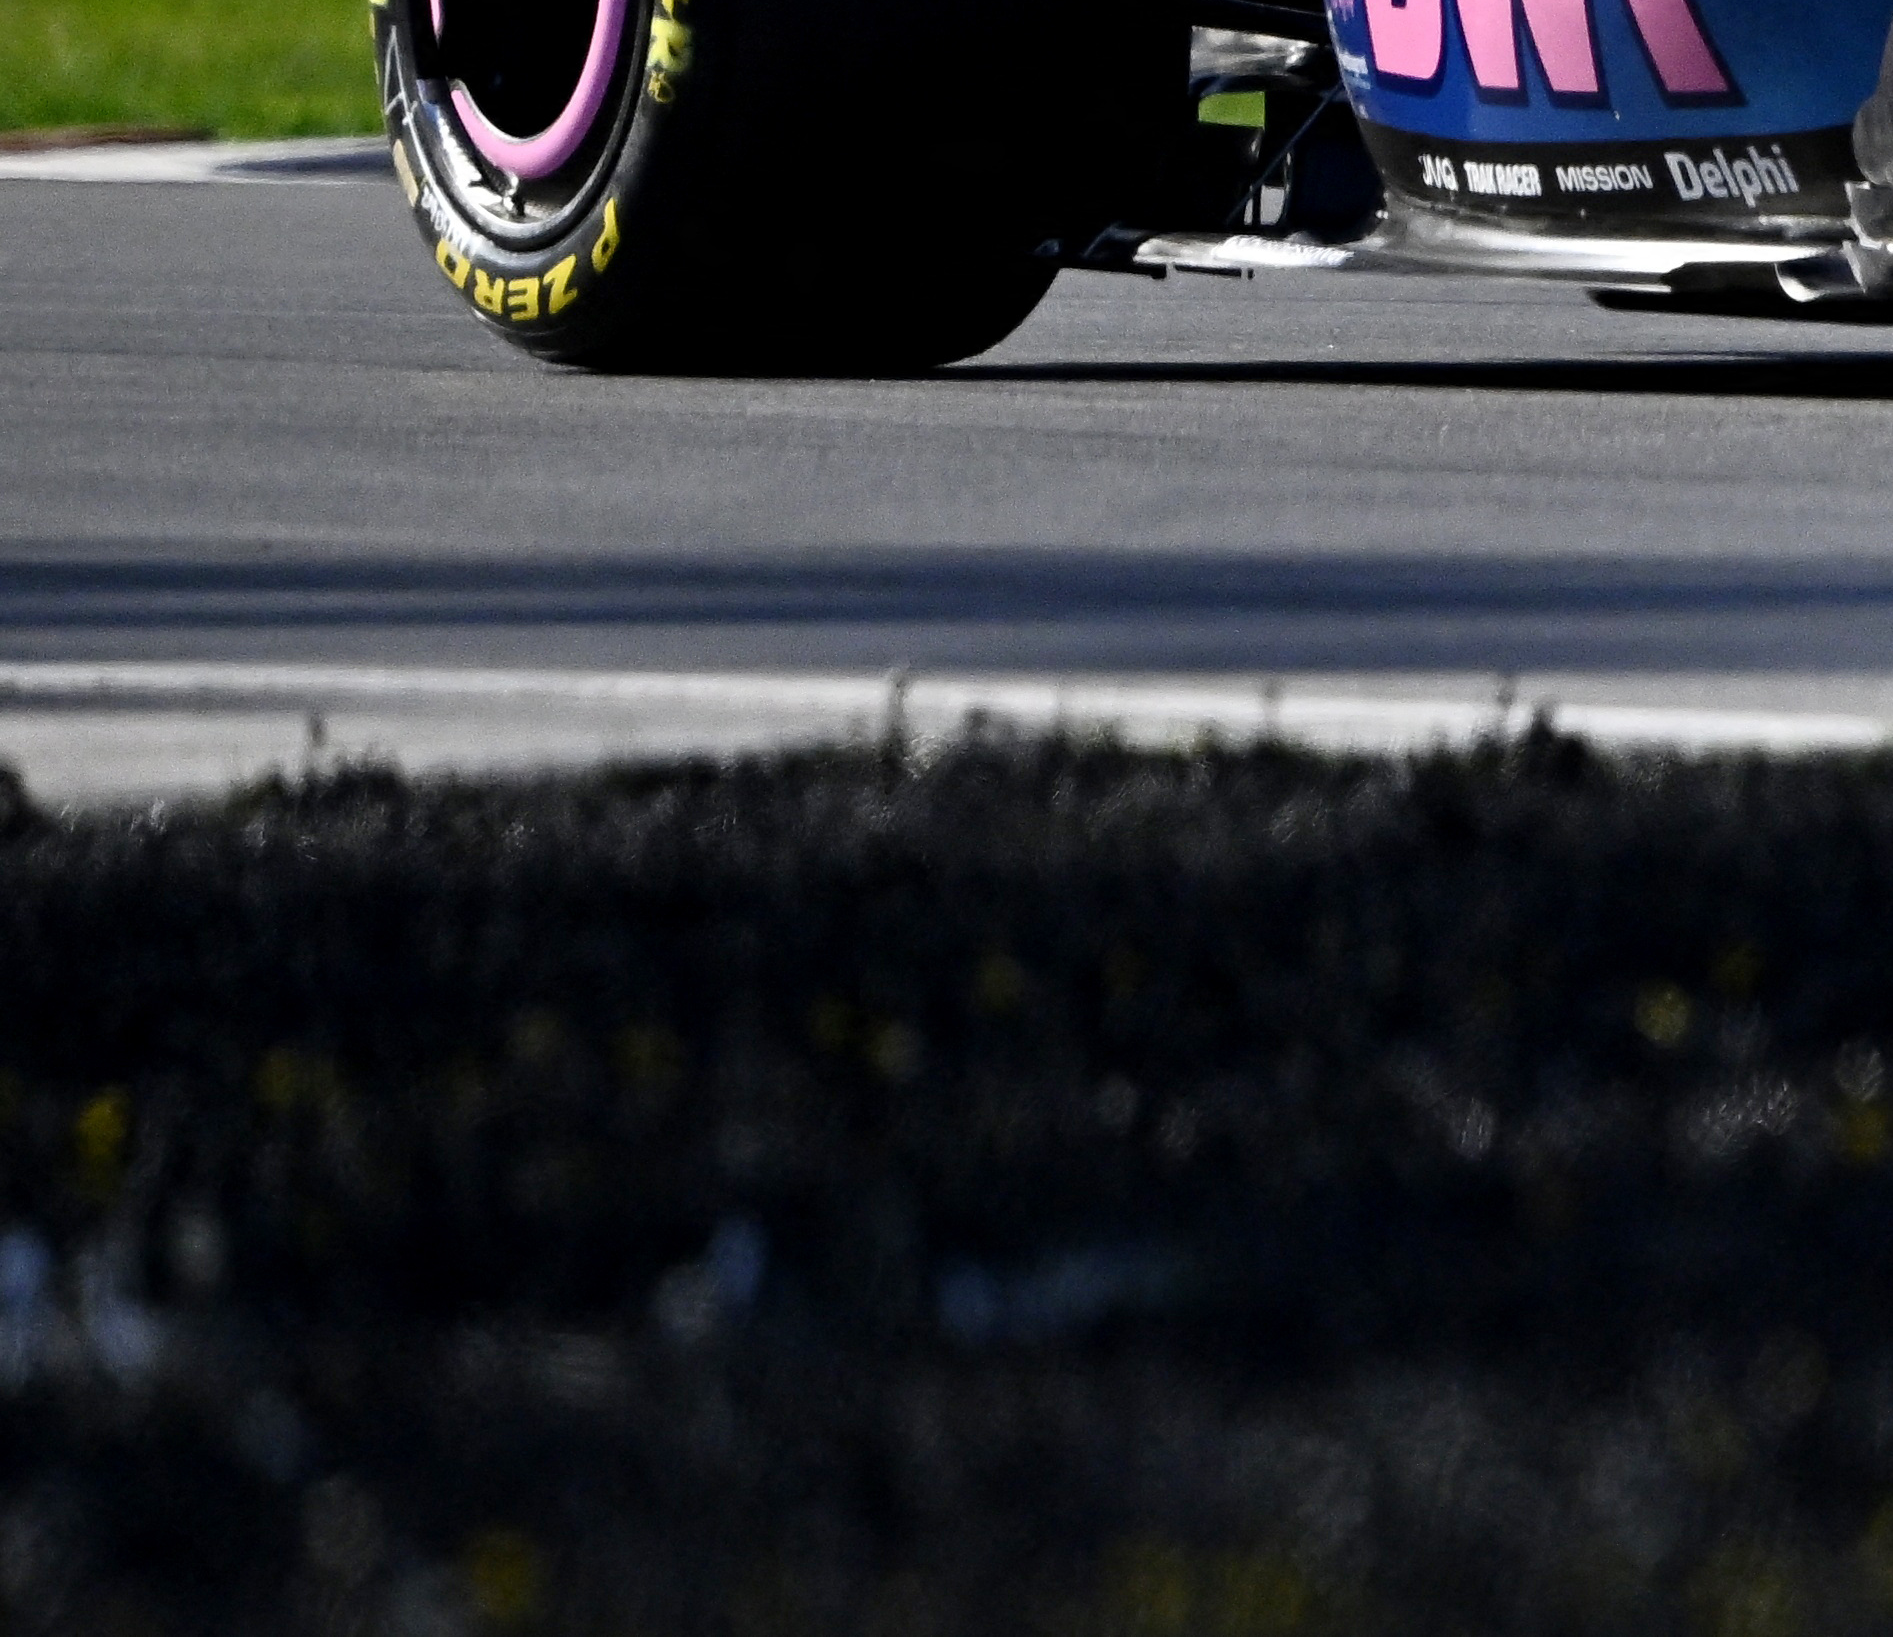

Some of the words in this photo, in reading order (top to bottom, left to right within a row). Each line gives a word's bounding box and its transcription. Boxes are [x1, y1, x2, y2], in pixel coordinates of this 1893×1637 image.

[1555, 164, 1654, 192] MISSION
[1664, 144, 1800, 208] Delphi
[591, 197, 620, 273] P
[435, 237, 577, 322] ZERO
